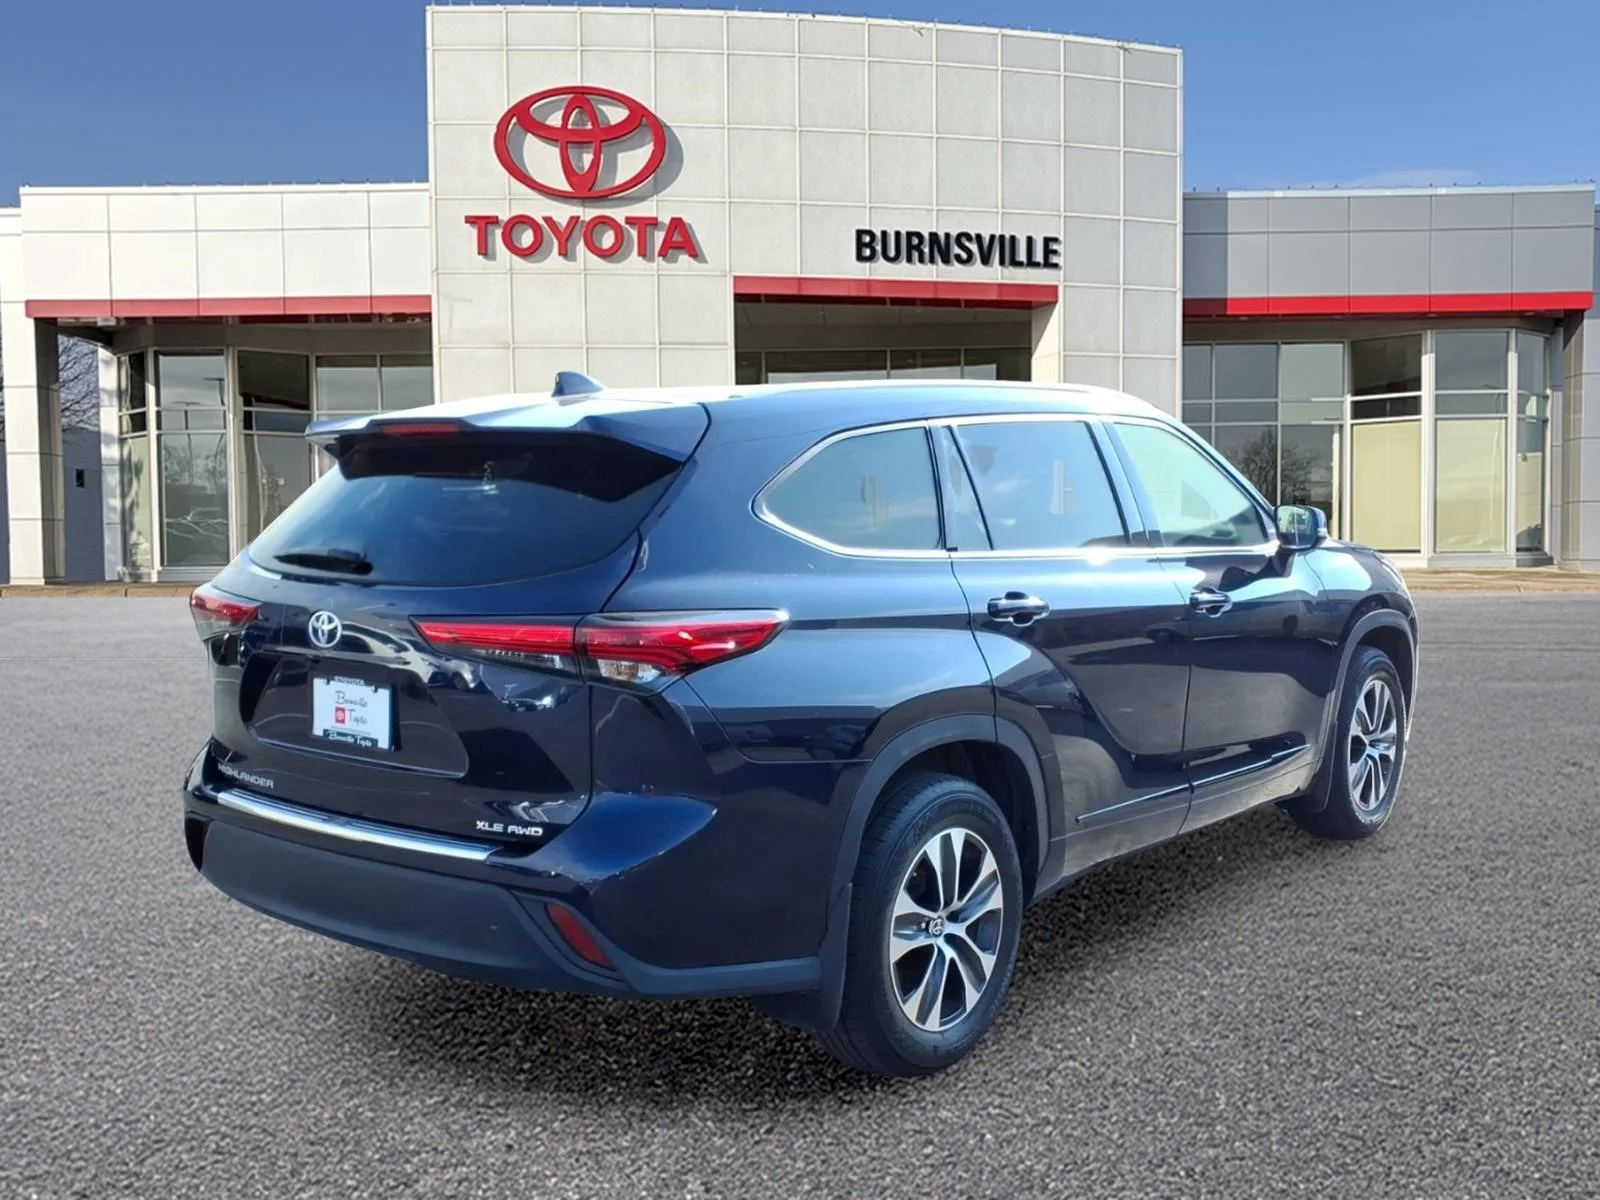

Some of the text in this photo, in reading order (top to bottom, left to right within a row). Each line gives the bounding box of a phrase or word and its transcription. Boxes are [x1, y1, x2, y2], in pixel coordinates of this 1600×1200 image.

[465, 214, 699, 258] TOYOTA
[855, 229, 1061, 269] BURNSVILLE
[476, 820, 543, 836] XLE AWD
